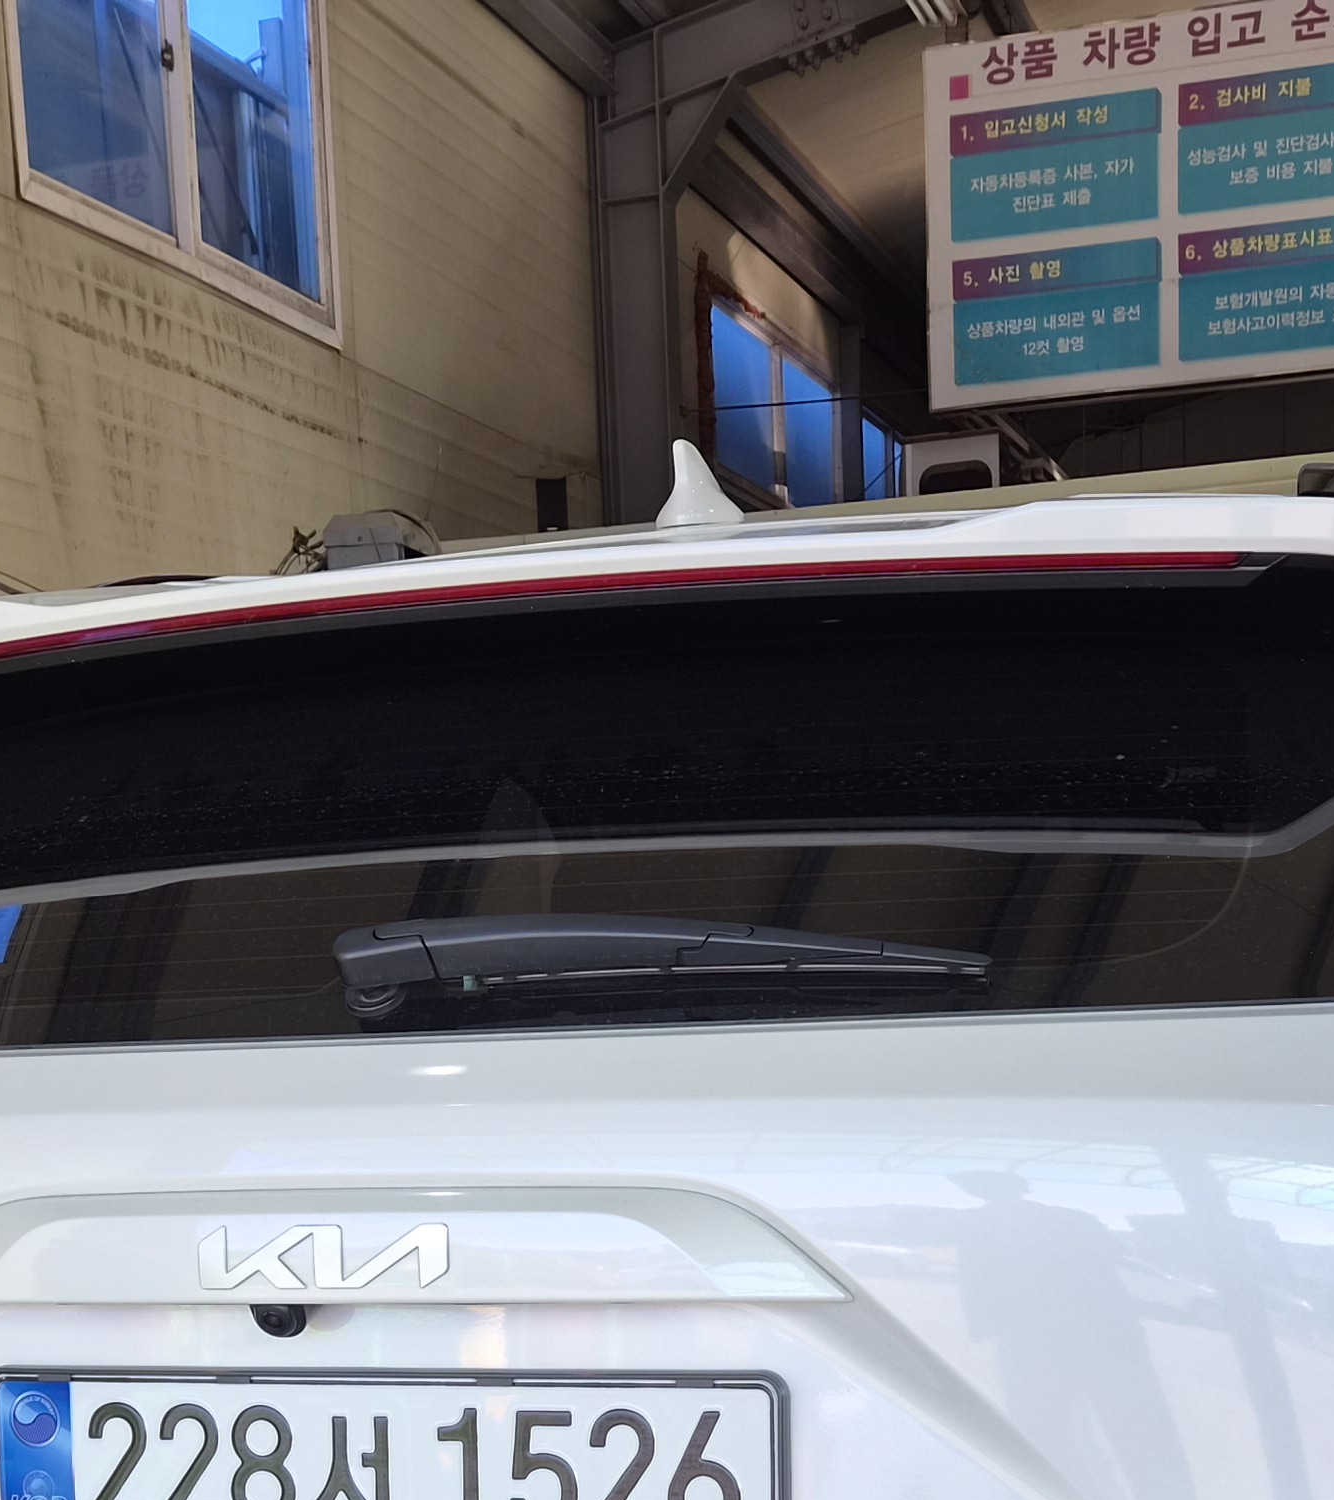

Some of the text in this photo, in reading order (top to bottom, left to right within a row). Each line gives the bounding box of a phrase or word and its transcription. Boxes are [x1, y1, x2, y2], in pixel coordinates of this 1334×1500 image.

[982, 38, 1057, 85] 상품
[1082, 22, 1161, 69] 차량
[1187, 10, 1266, 57] 입고
[1189, 77, 1312, 110] 2. 검사비 지불
[985, 110, 1066, 139] 입고신청서
[1076, 105, 1108, 125] 작성
[1187, 143, 1246, 166] 성능검사
[1254, 140, 1267, 157] 및
[970, 167, 1057, 193] 자동차등록증
[1105, 157, 1135, 175] 자가
[1229, 157, 1333, 185] 보증 비용 지불
[1013, 187, 1091, 213] 진단표 제출
[1185, 245, 1201, 261] 6.
[1213, 229, 1333, 258] 상품차량표시표
[963, 260, 1061, 287] 5. 사진 촬영
[1215, 286, 1302, 310] 보험개발원의
[967, 304, 1140, 339] 상품차량의 내외관 및 옵션
[1207, 310, 1325, 336] 보험사고이력정보
[1022, 336, 1084, 356] 12컷 촬영
[198, 1223, 449, 1290] KIA
